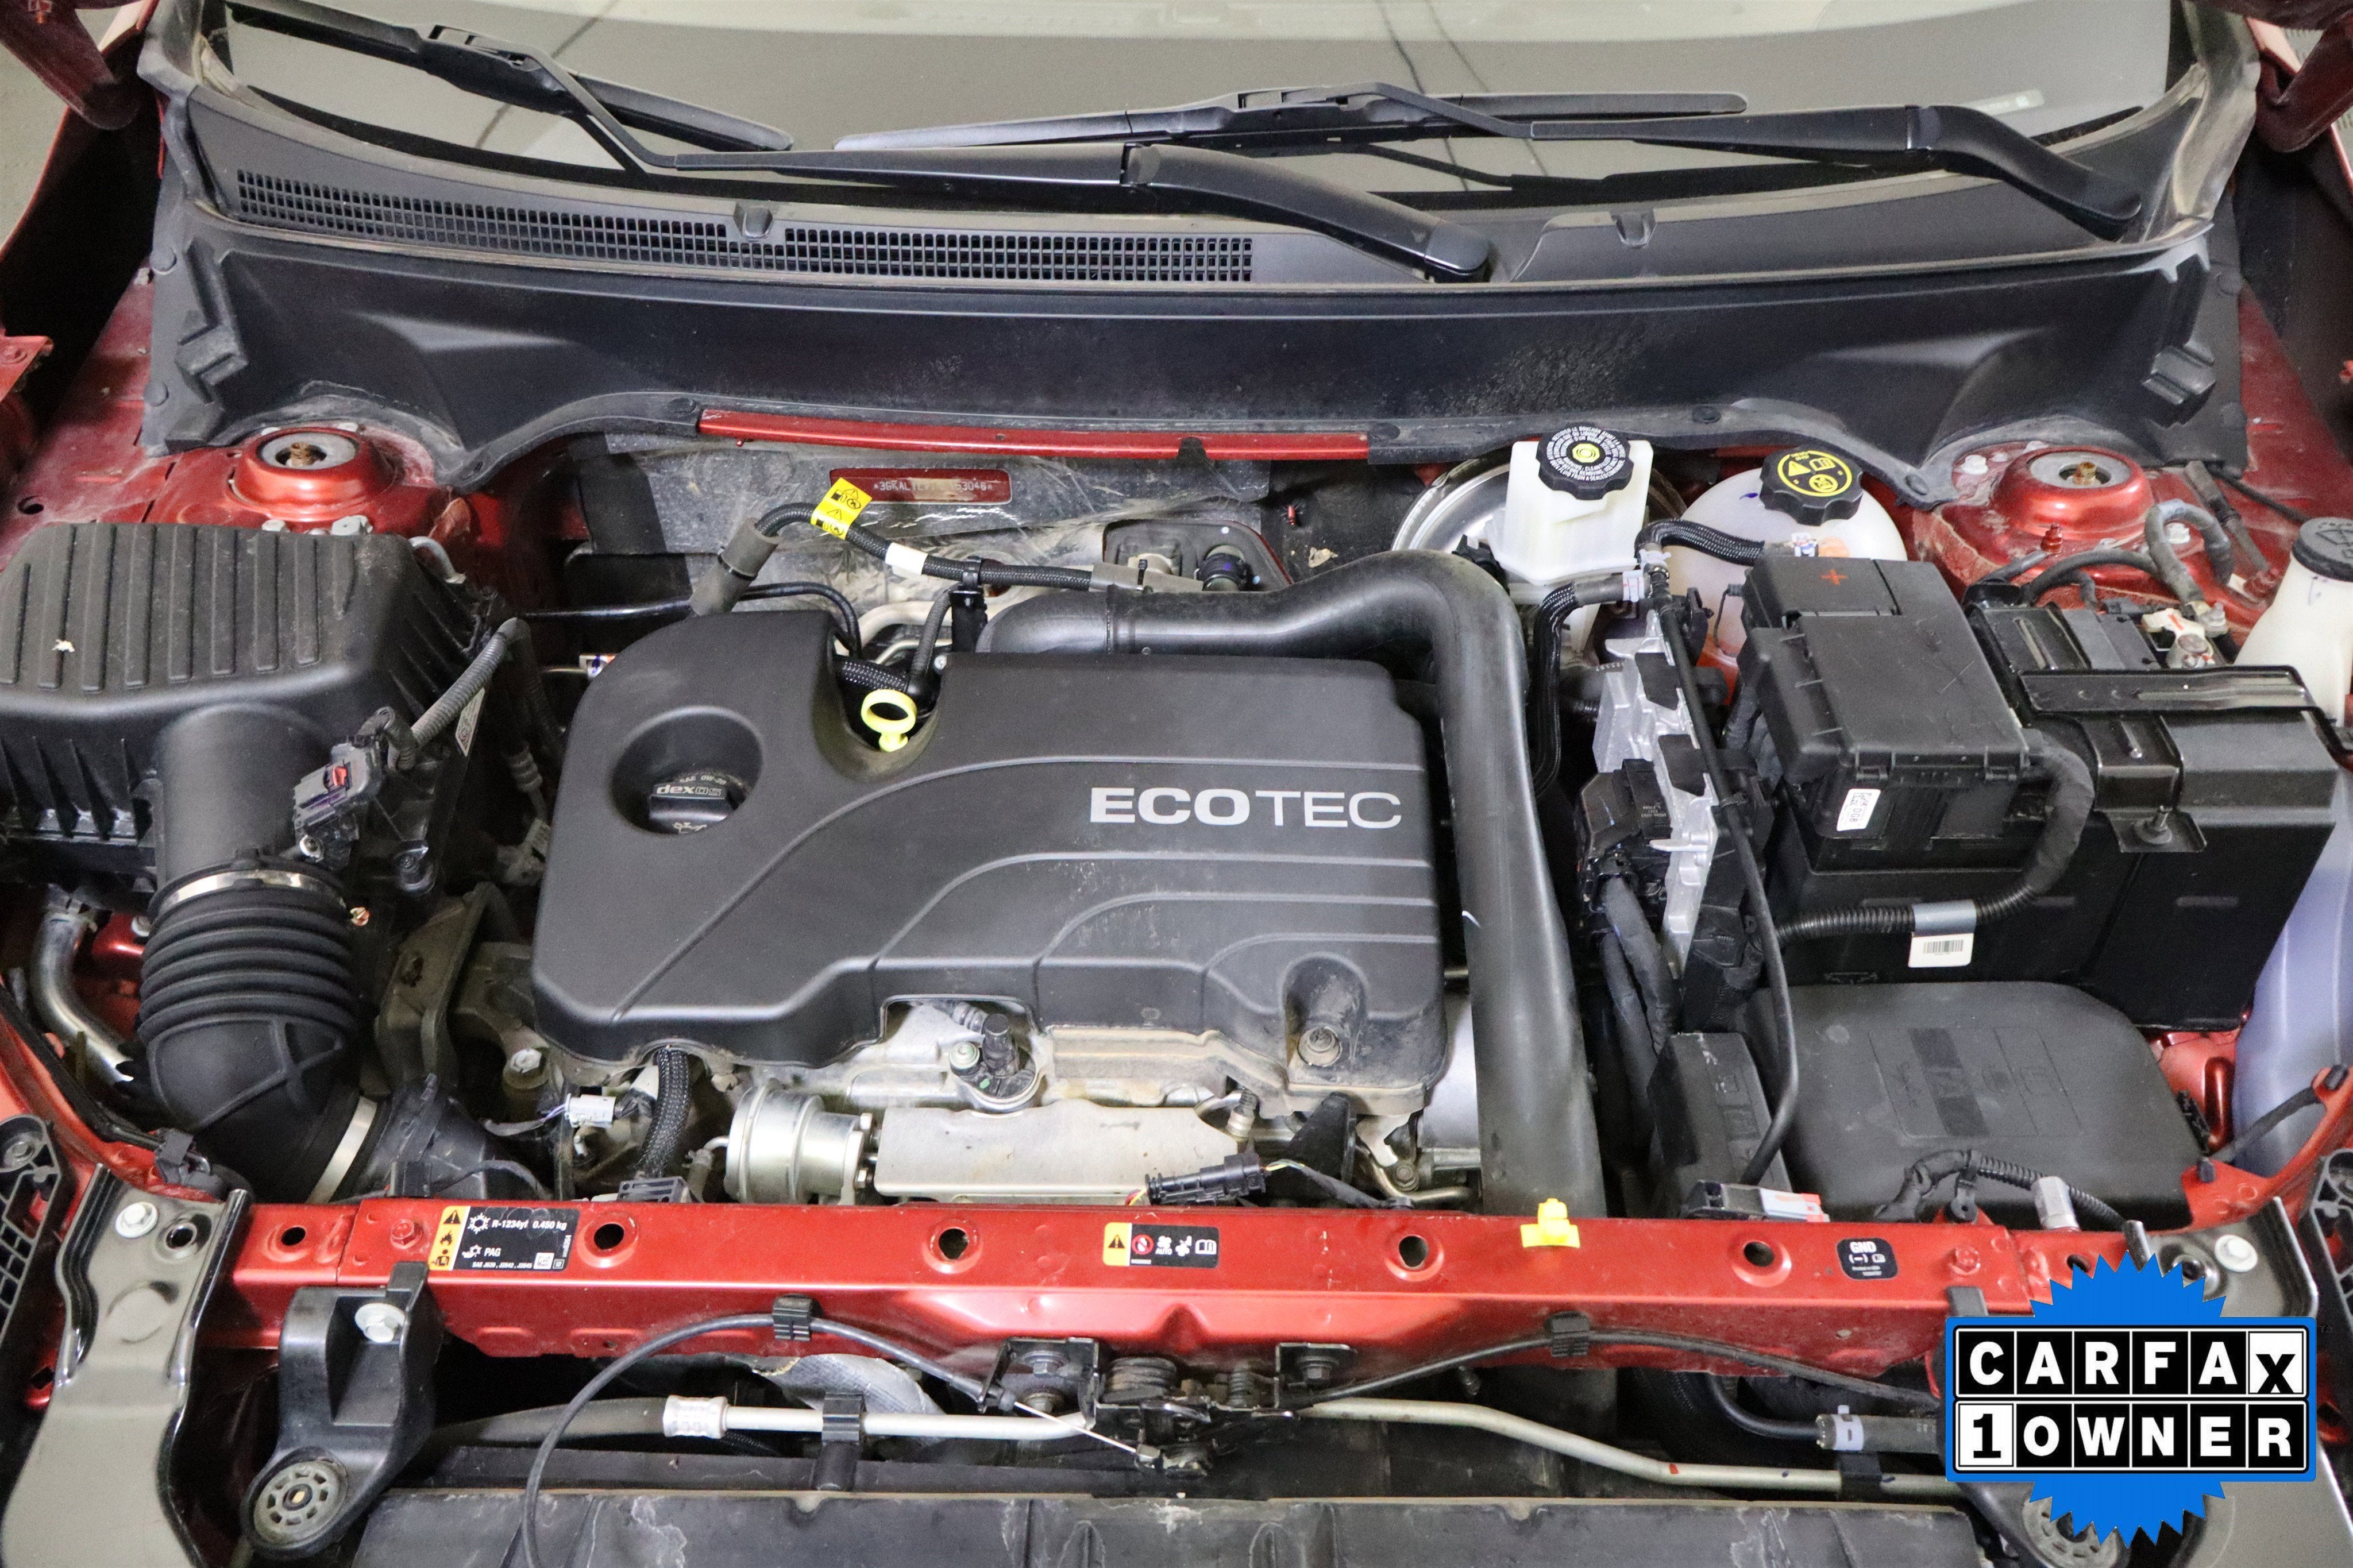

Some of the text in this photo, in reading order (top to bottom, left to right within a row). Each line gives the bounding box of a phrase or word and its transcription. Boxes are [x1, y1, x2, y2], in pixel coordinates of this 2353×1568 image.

[656, 784, 723, 797] dexos
[1090, 786, 1403, 829] ECOTEC
[492, 1219, 568, 1231] R-1234yf 0.450 kg
[484, 1248, 502, 1257] PAG
[1155, 1247, 1173, 1256] AUTO
[1850, 1241, 1877, 1254] GND
